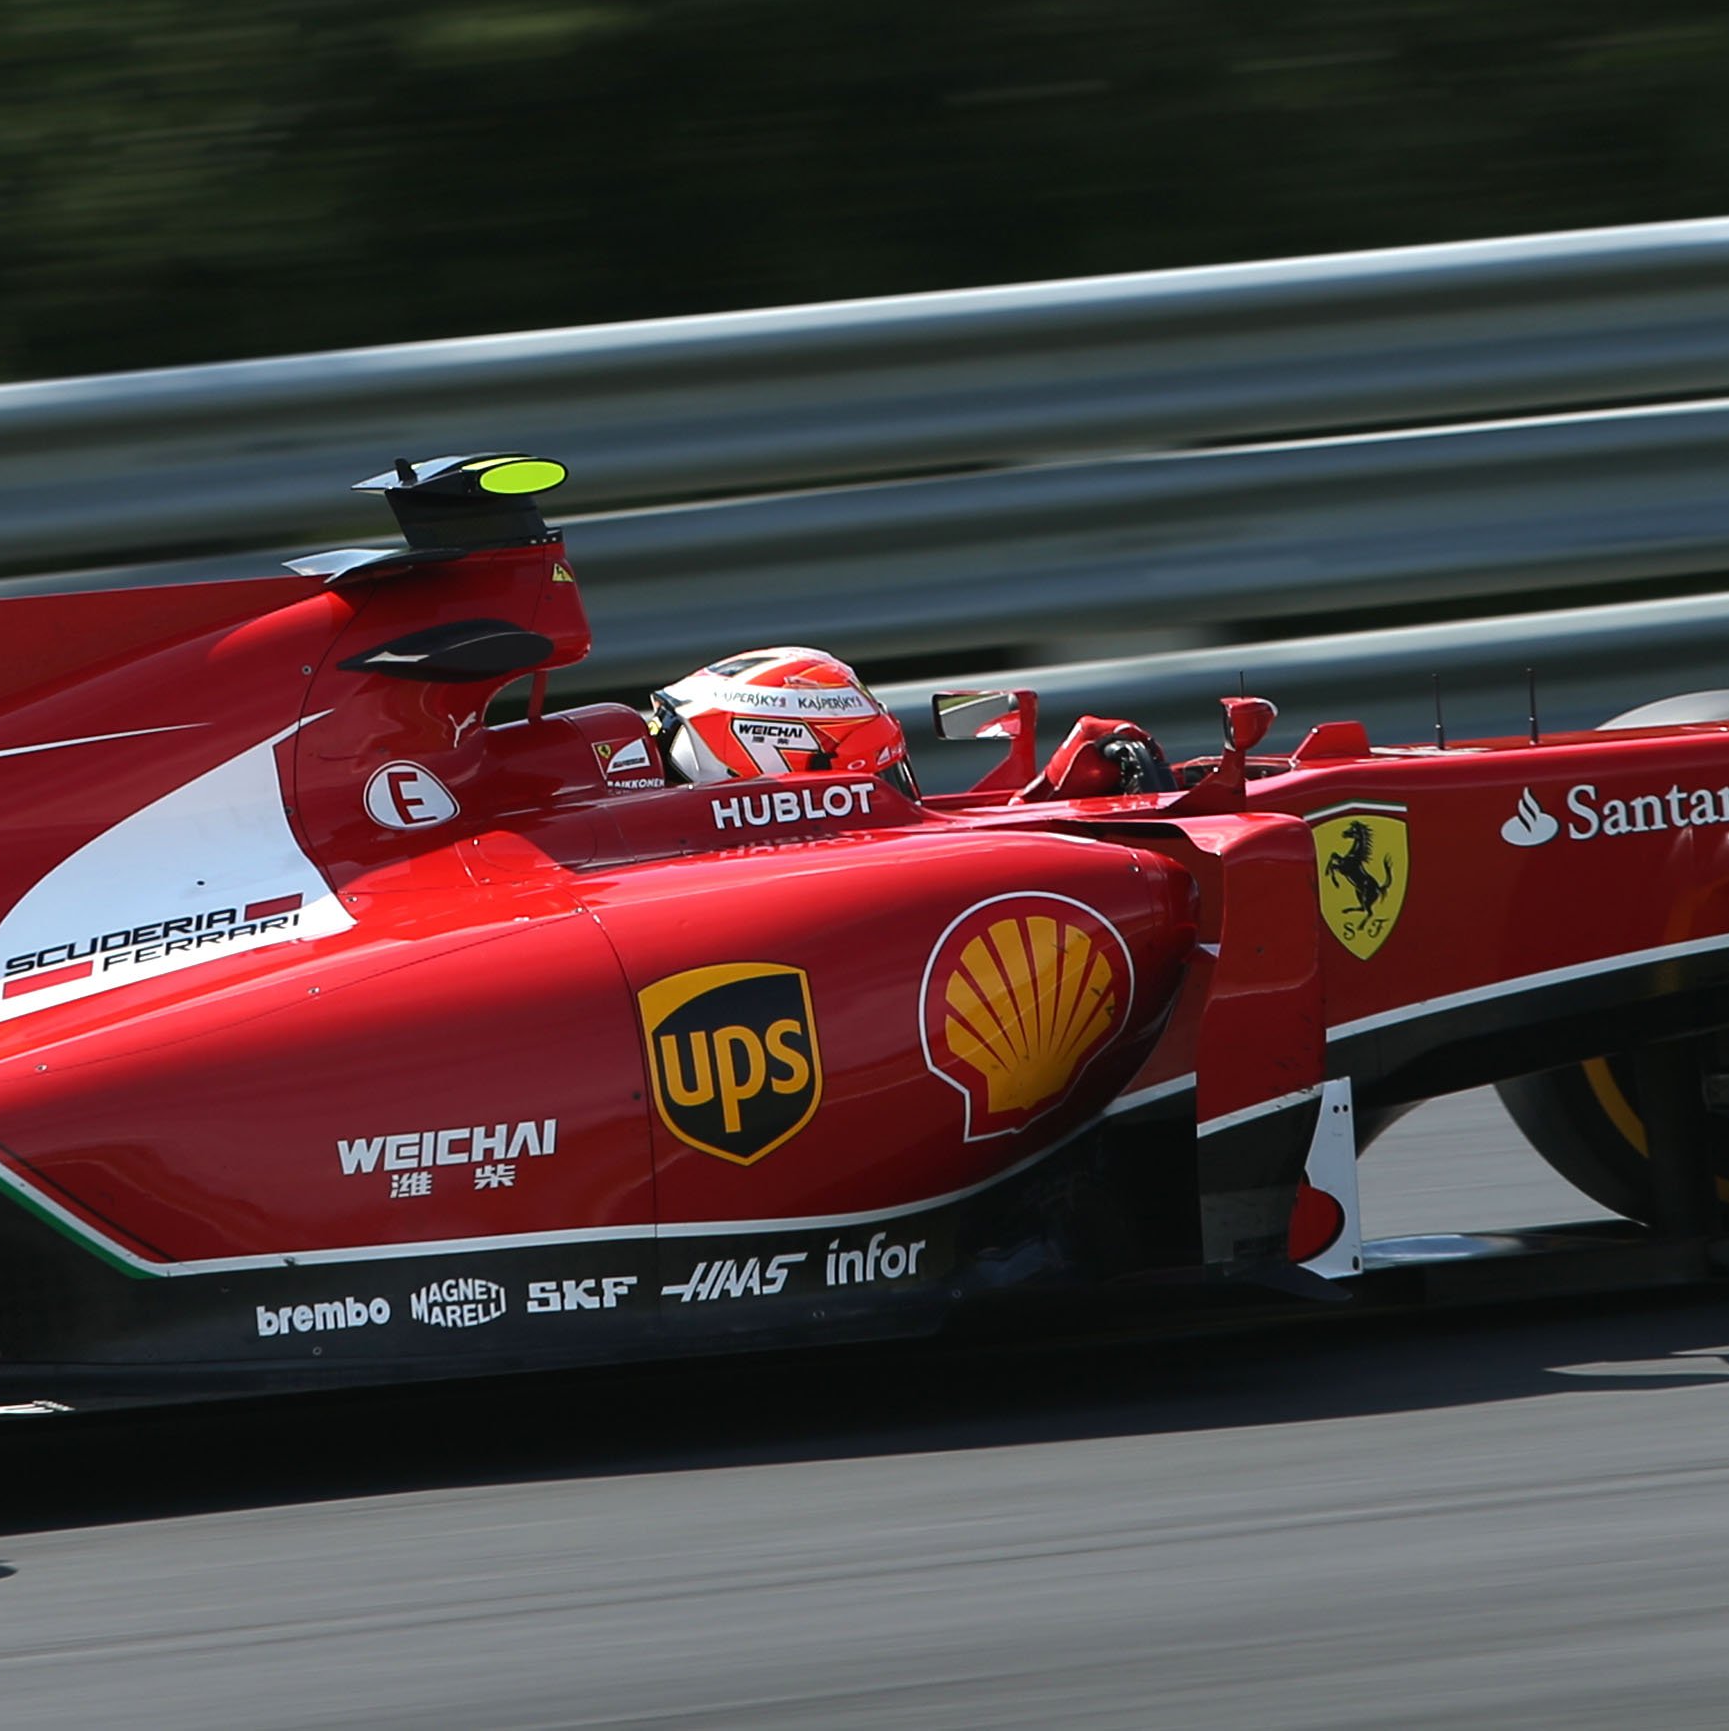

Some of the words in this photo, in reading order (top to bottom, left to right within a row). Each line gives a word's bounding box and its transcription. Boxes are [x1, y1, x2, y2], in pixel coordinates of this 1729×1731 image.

[798, 694, 856, 710] KASPERSKY
[738, 723, 803, 738] WEICHAI
[711, 783, 874, 829] HUBLOT
[3, 908, 238, 976] SCUDERIA
[101, 913, 300, 972] FERRARI
[659, 1019, 809, 1132] ups
[337, 1118, 557, 1175] WEICHAI
[661, 1253, 807, 1303] HAAS
[826, 1233, 925, 1286] infor
[256, 1295, 391, 1337] brembo
[411, 1278, 506, 1313] MAGNETI
[411, 1290, 506, 1327] MARELLI
[527, 1275, 637, 1313] SKF
